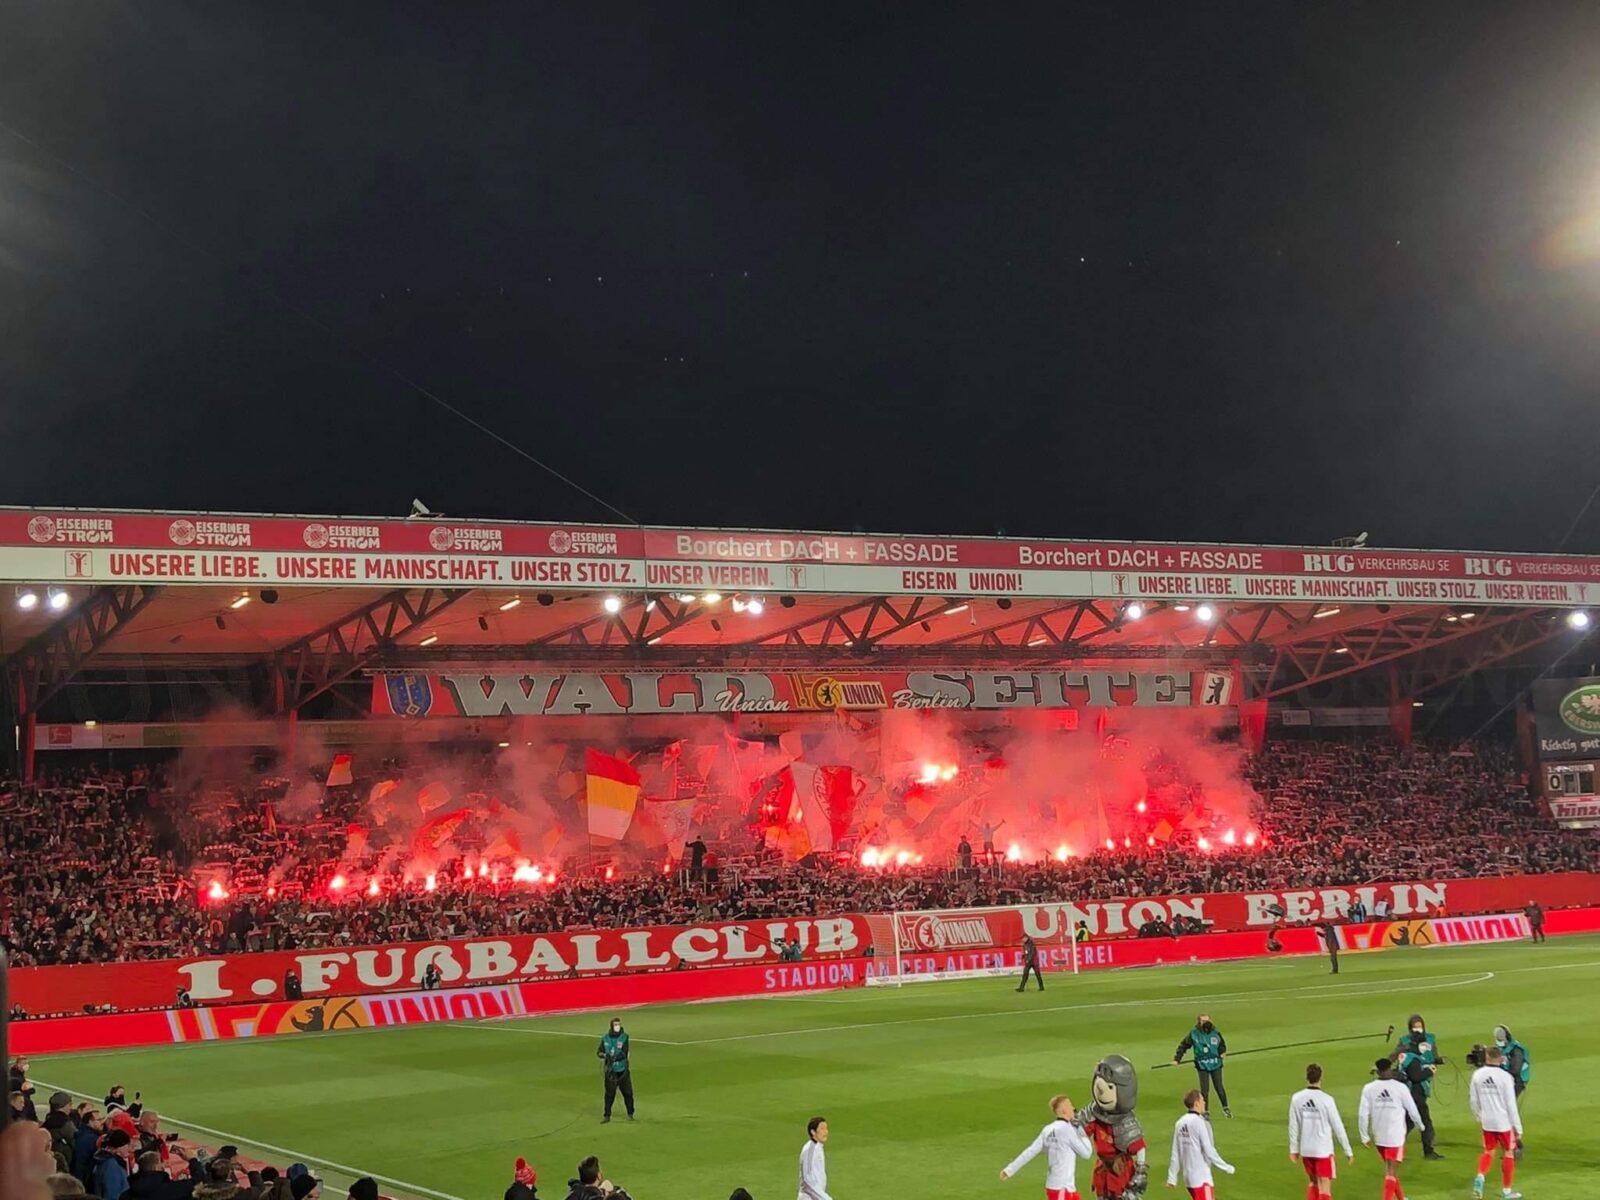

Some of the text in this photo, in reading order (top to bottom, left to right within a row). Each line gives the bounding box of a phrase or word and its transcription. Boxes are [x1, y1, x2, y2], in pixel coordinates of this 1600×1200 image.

[56, 518, 112, 530] EISERNER
[196, 522, 250, 533] EISERNER
[328, 525, 379, 537] EISERNER
[56, 530, 113, 542] STROM
[196, 533, 251, 546] STROM
[328, 537, 380, 549] STROM
[454, 528, 501, 540] EISERNER
[571, 532, 616, 543] EISERNER
[454, 540, 502, 551] STROM
[571, 543, 617, 554] STROM
[676, 535, 772, 558] Borchert
[780, 540, 839, 559] DACH
[864, 542, 959, 562] FASSADE
[1019, 546, 1101, 566] Borchert
[1108, 550, 1159, 567] DACH
[1180, 551, 1263, 569] FASSADE
[1303, 554, 1450, 572] BUG VERKEHRSBAU SE
[110, 553, 775, 586] UNSERE LIEBE. UNSERE MANNSCHAFT. UNSER STOLZ. UNSER VEREIN.
[1464, 558, 1512, 576] BUG
[1516, 562, 1588, 575] VERKEHRSBAU
[902, 570, 1023, 591] EISERN UNION!
[1138, 576, 1572, 601] UNSERE LIEBE. UNSERE MANNSCHAFT. UNSER STOLZ. UNSER VEREIN.
[443, 671, 1191, 716] WALD SEITE
[714, 689, 962, 713] Union Berlin
[841, 684, 888, 705] UNION
[1550, 774, 1560, 789] 0
[177, 960, 277, 999] 1.
[1018, 898, 1214, 939] UNION
[1244, 882, 1447, 925] BERLIN
[943, 920, 990, 945] UNION
[764, 963, 854, 988] STADION
[901, 957, 937, 974] DER
[946, 951, 1004, 973] ALTEN
[1014, 944, 1114, 969] FRSTEREI
